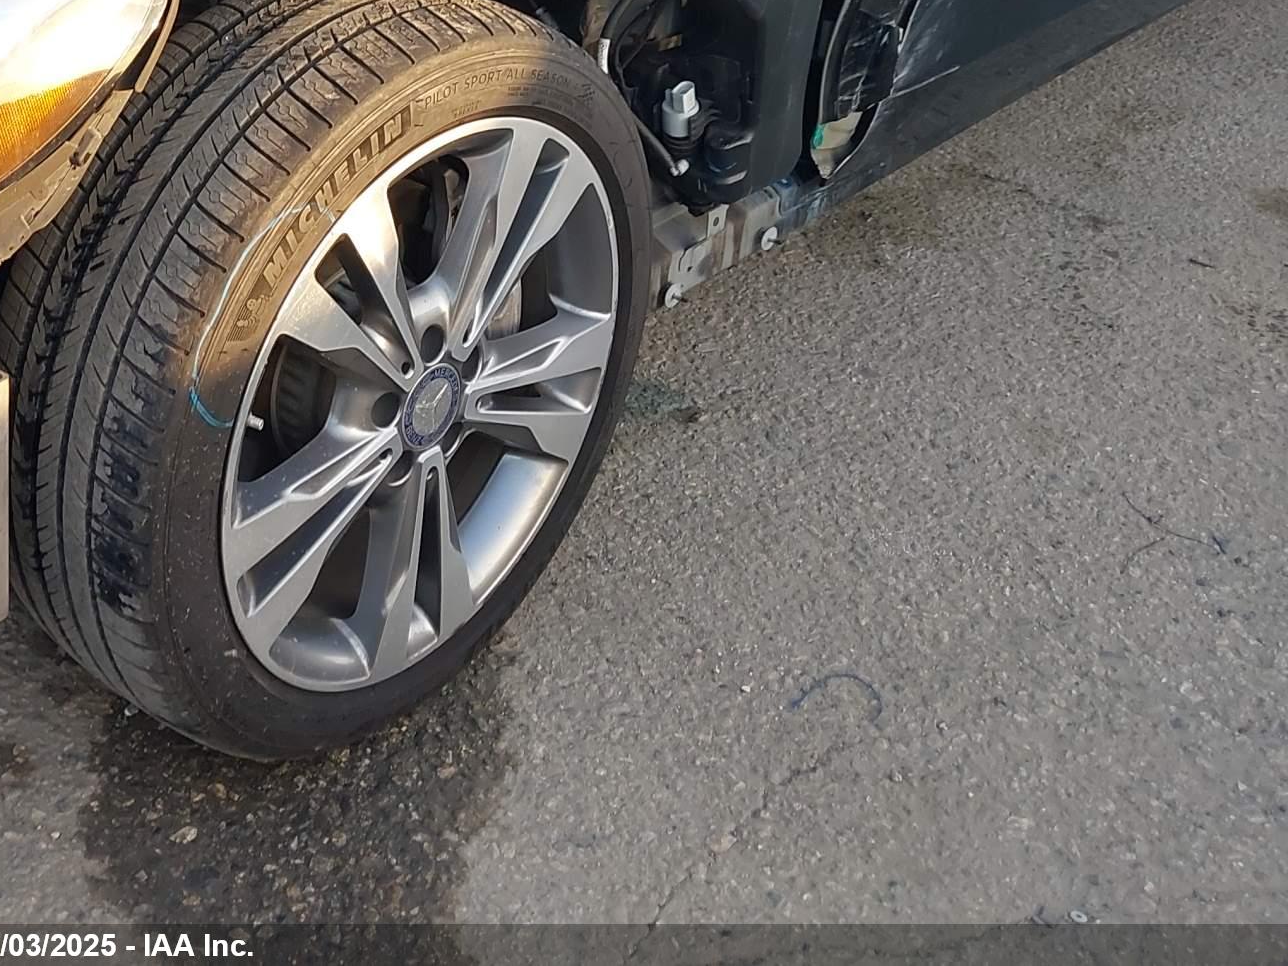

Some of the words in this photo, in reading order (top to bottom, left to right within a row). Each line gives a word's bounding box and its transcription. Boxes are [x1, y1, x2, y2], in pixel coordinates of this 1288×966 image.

[424, 81, 460, 110] PILOT
[464, 69, 502, 91] SPORT
[506, 67, 528, 81] ALL
[530, 68, 571, 88] SEASON
[263, 113, 403, 285] MICHELIN
